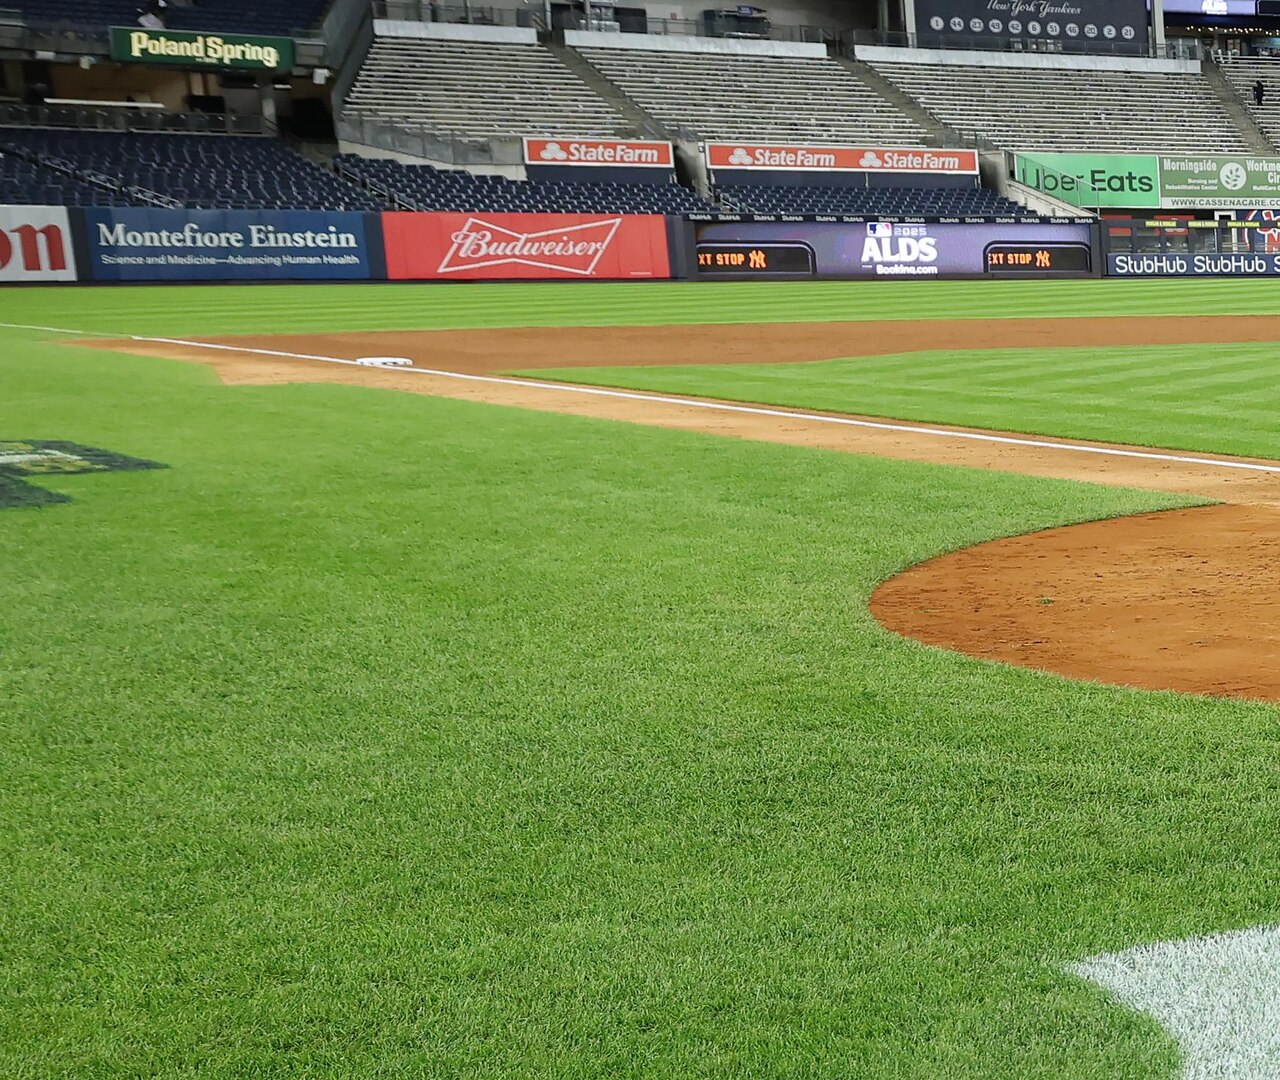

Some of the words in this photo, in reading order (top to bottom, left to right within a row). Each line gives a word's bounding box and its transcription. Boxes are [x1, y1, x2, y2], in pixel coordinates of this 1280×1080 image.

[1007, 0, 1036, 17] York
[1039, 0, 1082, 18] Yankees
[130, 31, 205, 57] Poland
[205, 36, 280, 68] Spring
[1163, 159, 1217, 173] Morningside
[1022, 168, 1084, 192] Uber
[1090, 169, 1153, 193] Eats
[97, 223, 245, 248] Montefiore
[248, 225, 358, 248] Einstein
[894, 227, 927, 236] 2025
[451, 230, 605, 258] Budweiser
[861, 237, 938, 262] ALDS
[101, 254, 145, 264] Science
[145, 255, 166, 265] and
[283, 255, 322, 265] Human
[322, 254, 360, 264] Health
[716, 253, 745, 265] STOP
[1007, 253, 1031, 265] STOP
[1115, 255, 1187, 274] StubHub
[1193, 255, 1266, 274] StubHub
[876, 264, 938, 275] Booking.com
